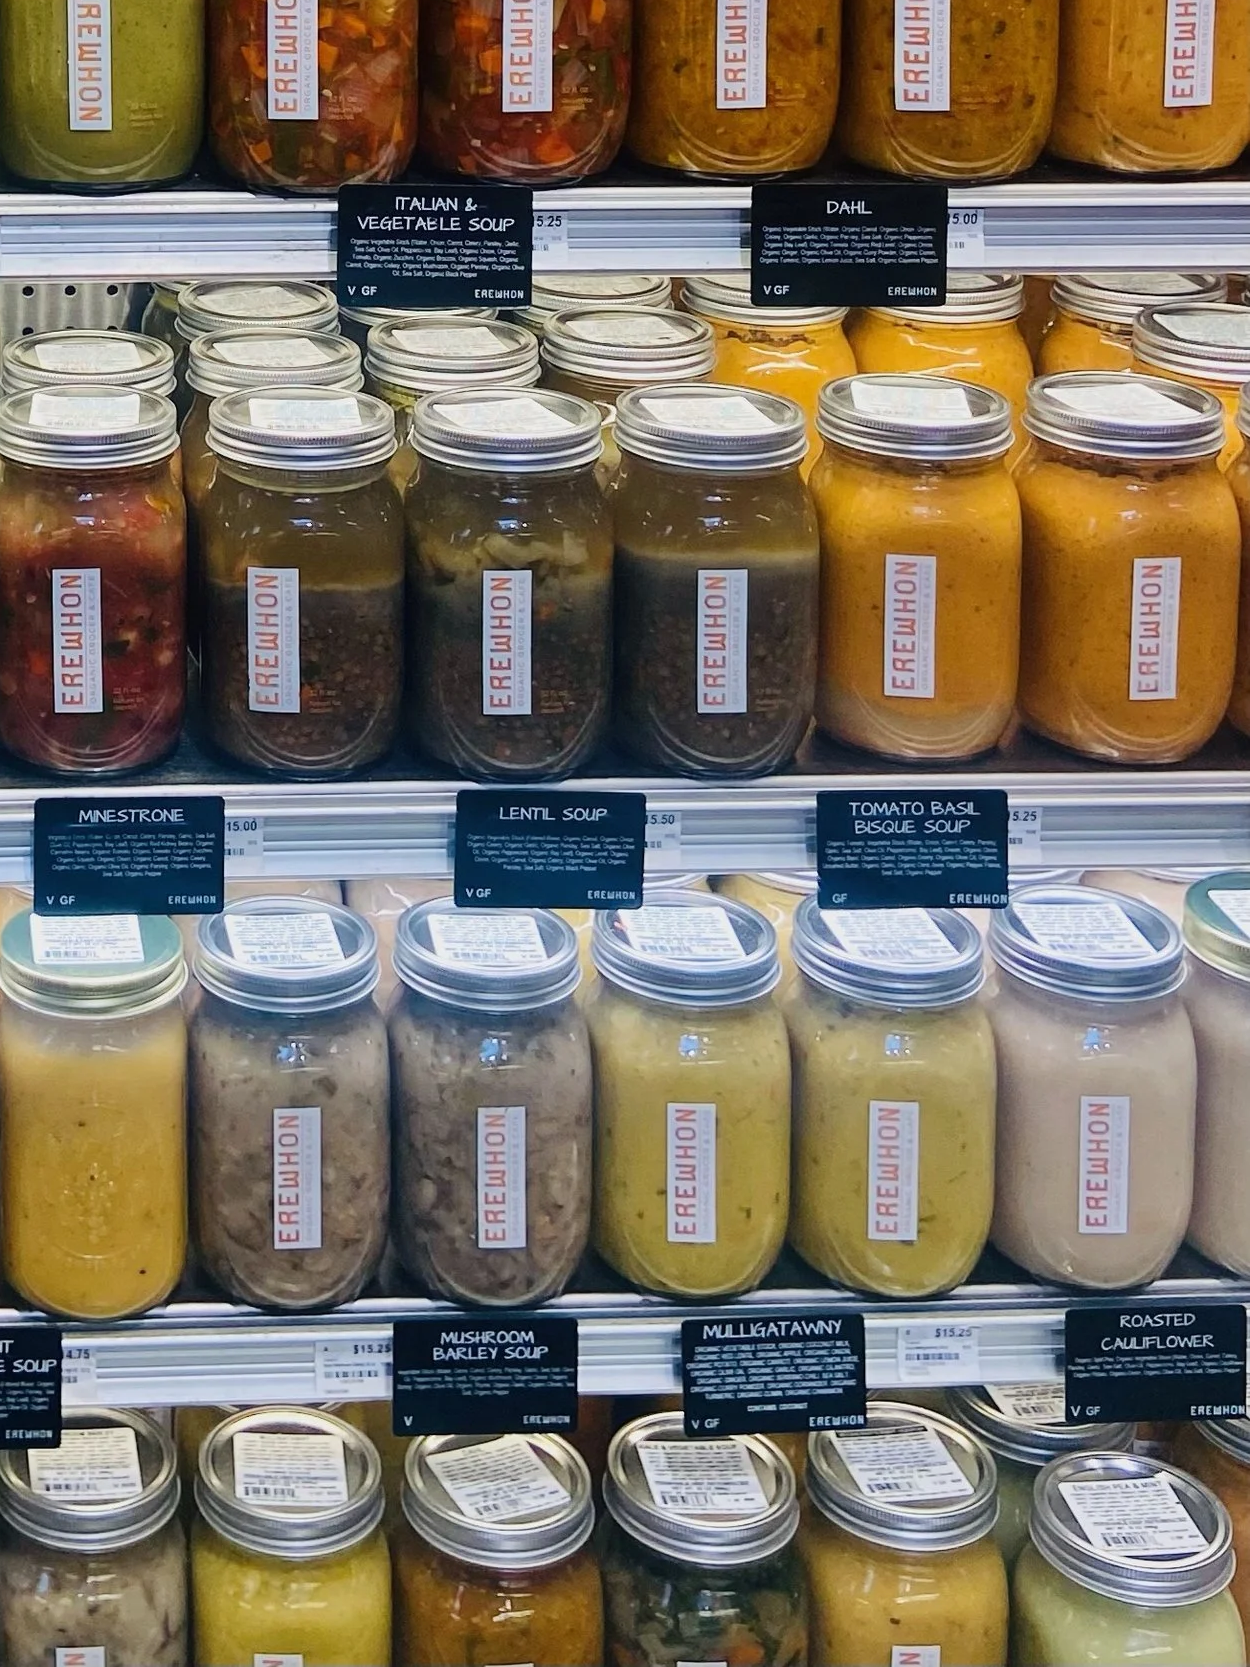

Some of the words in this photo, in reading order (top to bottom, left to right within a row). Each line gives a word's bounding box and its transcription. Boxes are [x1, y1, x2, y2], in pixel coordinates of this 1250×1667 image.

[395, 196, 458, 212] ITALIAN
[464, 197, 478, 212] &
[826, 200, 873, 215] DAHL
[357, 215, 462, 232] VEGETABLE
[468, 217, 515, 232] SOUP
[347, 285, 357, 296] V
[361, 285, 378, 296] GF
[1136, 564, 1163, 693] EREWHON
[253, 573, 279, 704] EREWHON
[499, 806, 556, 821] LENTIL
[562, 807, 608, 822] SOUP
[848, 801, 925, 816] TOMATO
[930, 801, 981, 816] BASIL
[74, 808, 185, 827] MINESTRONE
[226, 817, 258, 832] 15.00
[854, 819, 917, 835] BISQUE
[923, 819, 971, 834] SOUP
[587, 890, 636, 900] EREWHON
[674, 1106, 697, 1235] EREWHON
[1085, 1102, 1109, 1227] EREWHON
[699, 1317, 842, 1340] MULLIGATAWNY
[1119, 1313, 1196, 1328] ROASTED
[440, 1330, 535, 1346] MUSHROOM
[1100, 1334, 1215, 1351] CAULIFLOWER
[432, 1346, 498, 1361] BARLEY
[503, 1345, 549, 1360] SOUP
[12, 1358, 58, 1373] SOUP
[1070, 1405, 1081, 1417] V
[1085, 1405, 1101, 1416] GF
[1190, 1404, 1246, 1416] EREWHON
[809, 1414, 865, 1427] EREWHON
